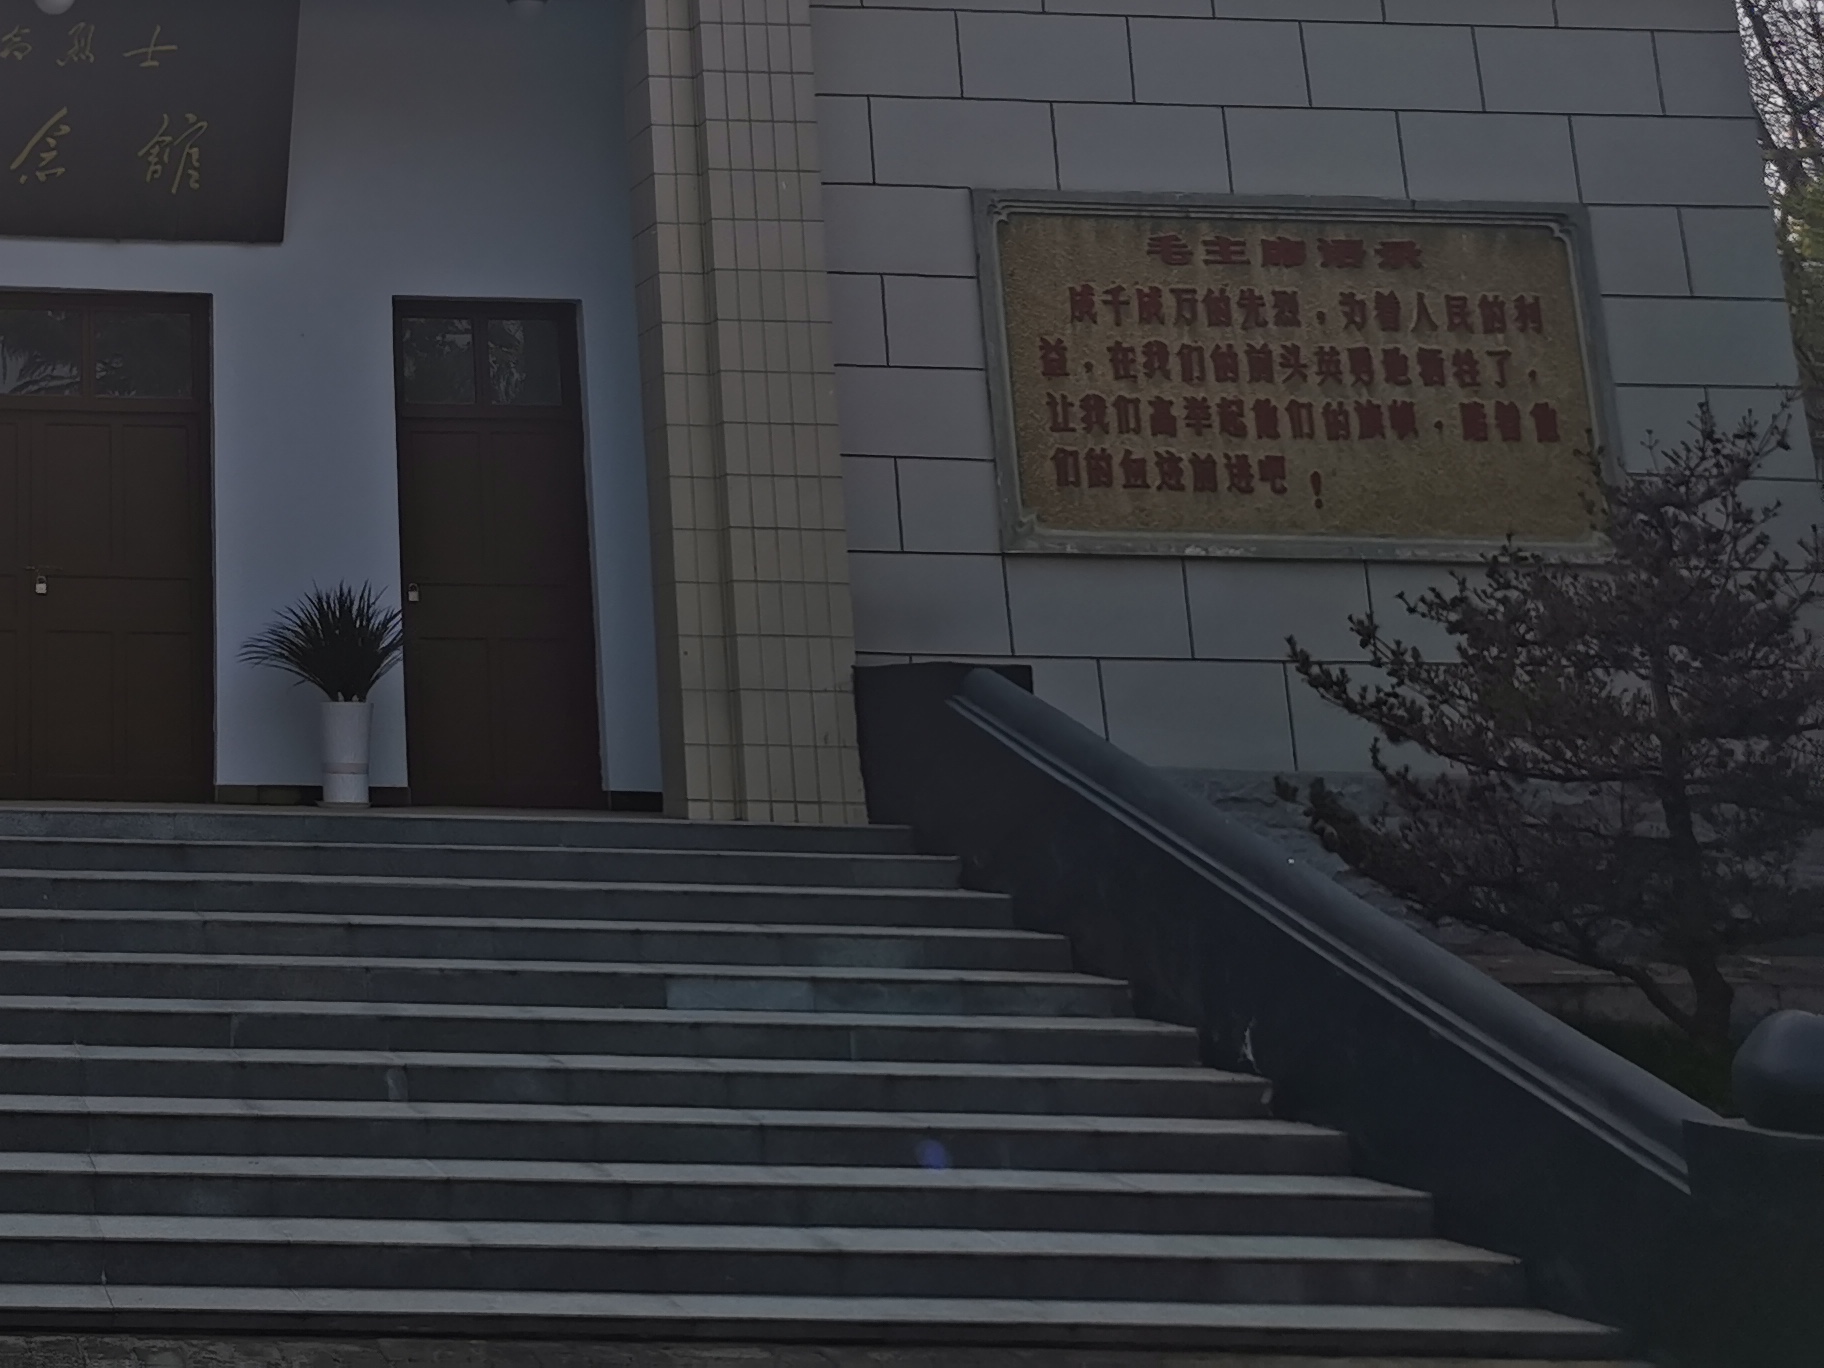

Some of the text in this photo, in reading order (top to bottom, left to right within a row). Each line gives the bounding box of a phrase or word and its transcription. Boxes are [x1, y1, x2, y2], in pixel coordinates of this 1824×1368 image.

[1146, 234, 1423, 270] 毛主席语录
